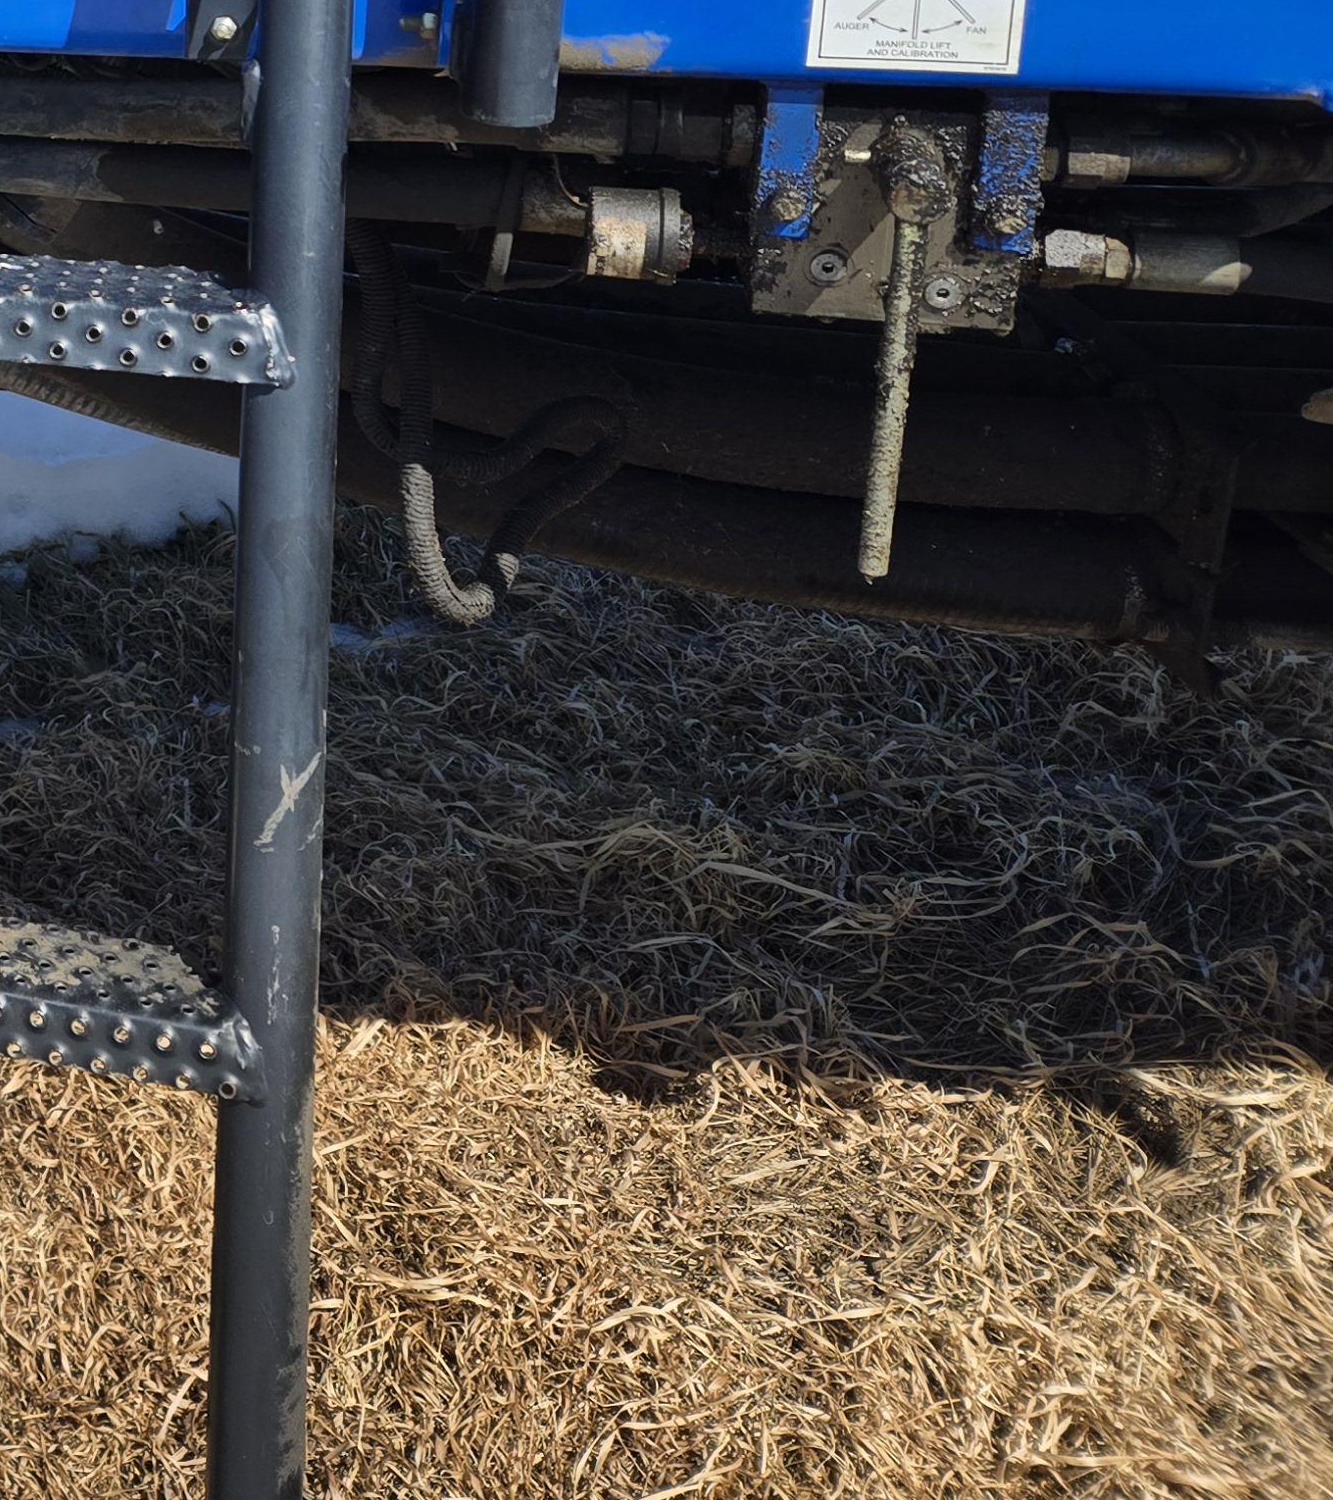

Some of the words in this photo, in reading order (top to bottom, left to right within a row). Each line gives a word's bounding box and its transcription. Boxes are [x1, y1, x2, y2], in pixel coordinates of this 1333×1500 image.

[834, 21, 870, 31] AUGER
[966, 26, 987, 35] FAN
[876, 40, 928, 49] MANIFOLD
[930, 41, 951, 50] LIFT
[866, 48, 889, 57] AND
[891, 49, 959, 59] CALIBRATION
